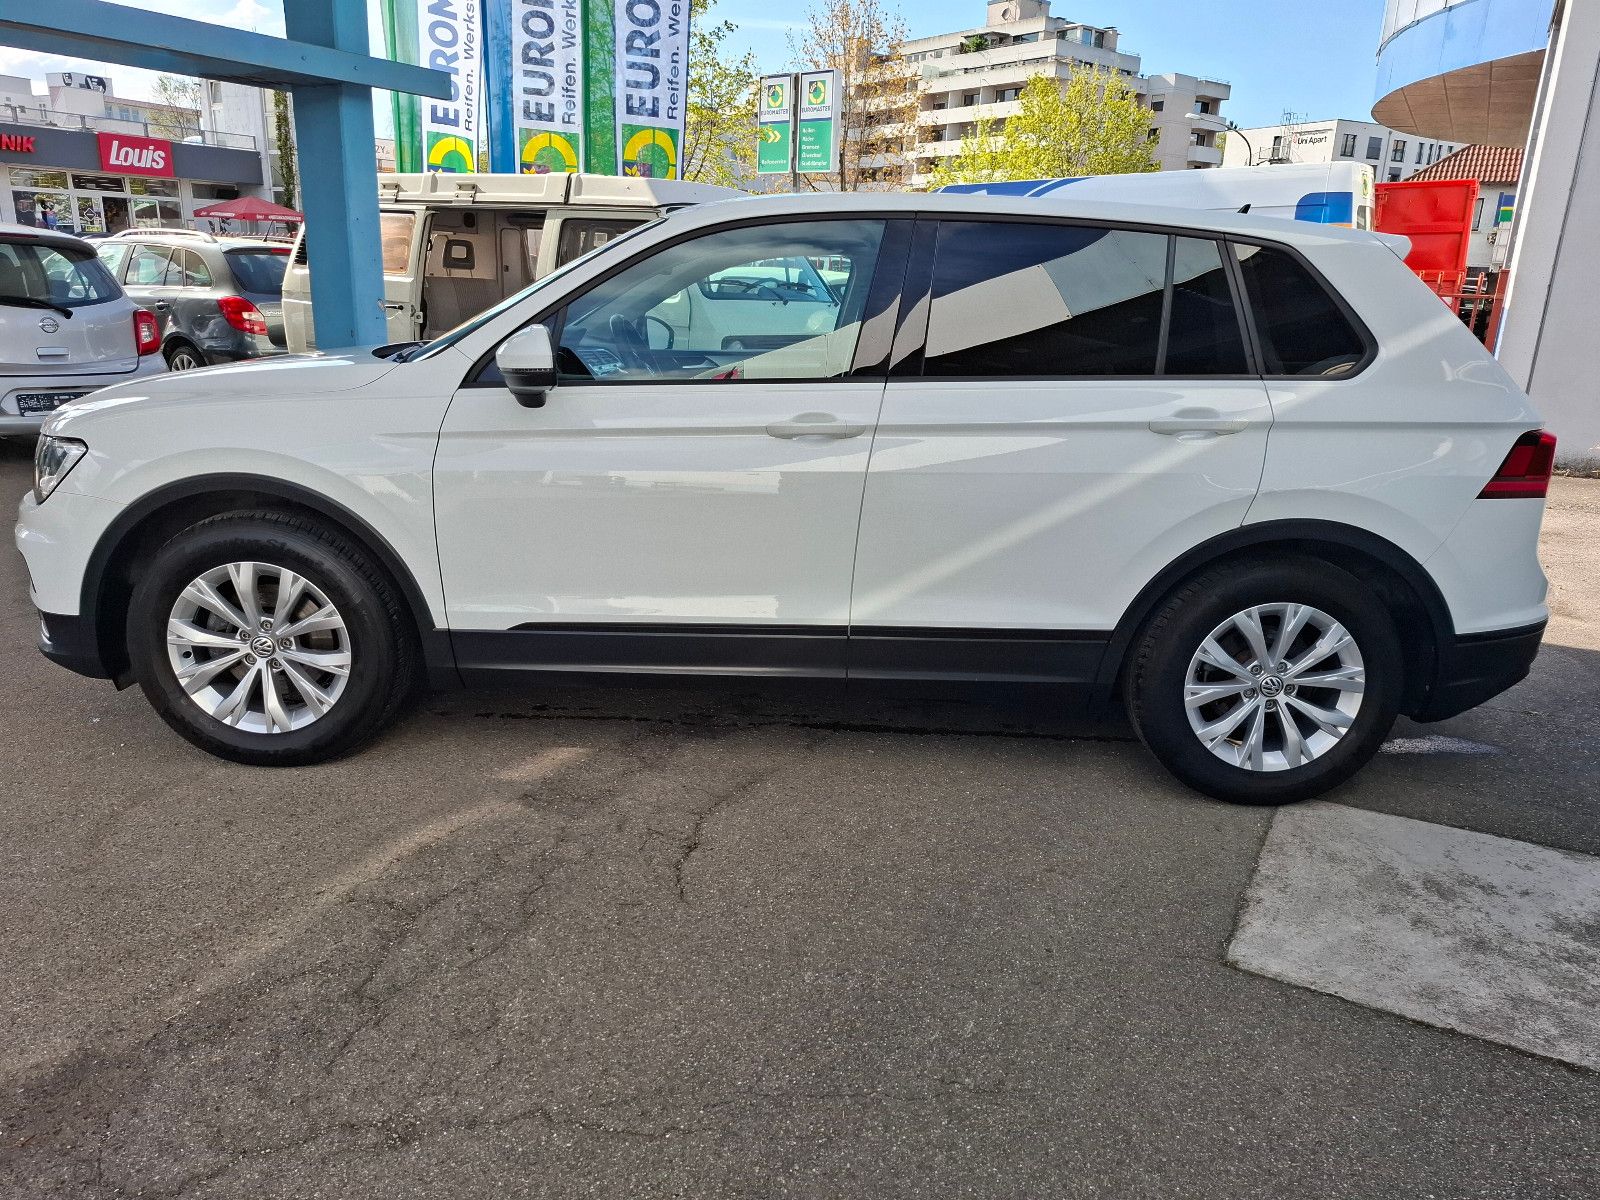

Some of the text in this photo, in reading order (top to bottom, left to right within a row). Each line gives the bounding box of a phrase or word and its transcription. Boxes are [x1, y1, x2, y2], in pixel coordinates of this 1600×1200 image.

[463, 0, 475, 132] Reifen. Werks
[561, 57, 577, 125] Reifen.
[625, 0, 661, 118] EURO
[667, 0, 681, 120] Reifen. We
[0, 133, 36, 153] NIK
[109, 140, 166, 169] Louis
[1297, 135, 1327, 145] Uni Apart
